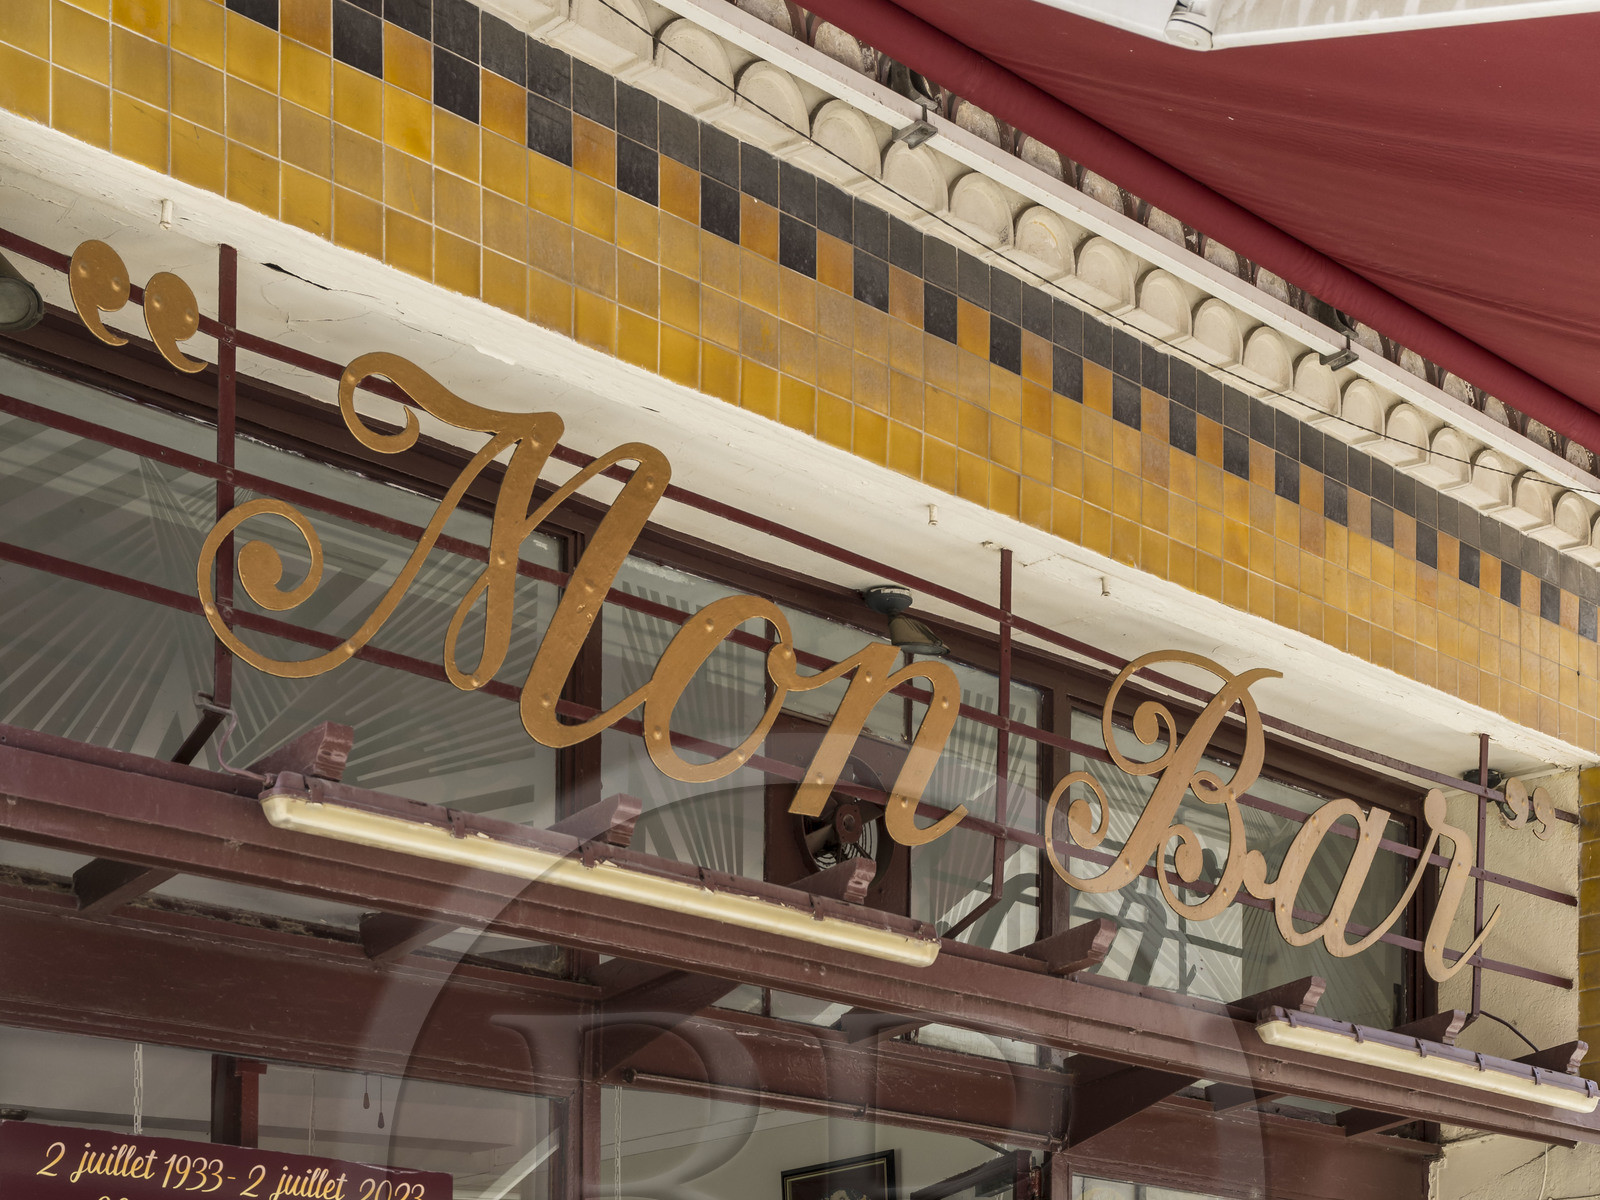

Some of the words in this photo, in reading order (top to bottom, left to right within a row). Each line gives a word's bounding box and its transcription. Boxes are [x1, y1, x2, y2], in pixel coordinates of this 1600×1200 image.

[37, 1142, 66, 1177] 2
[70, 1141, 158, 1183] juillet
[240, 1165, 266, 1198] 2
